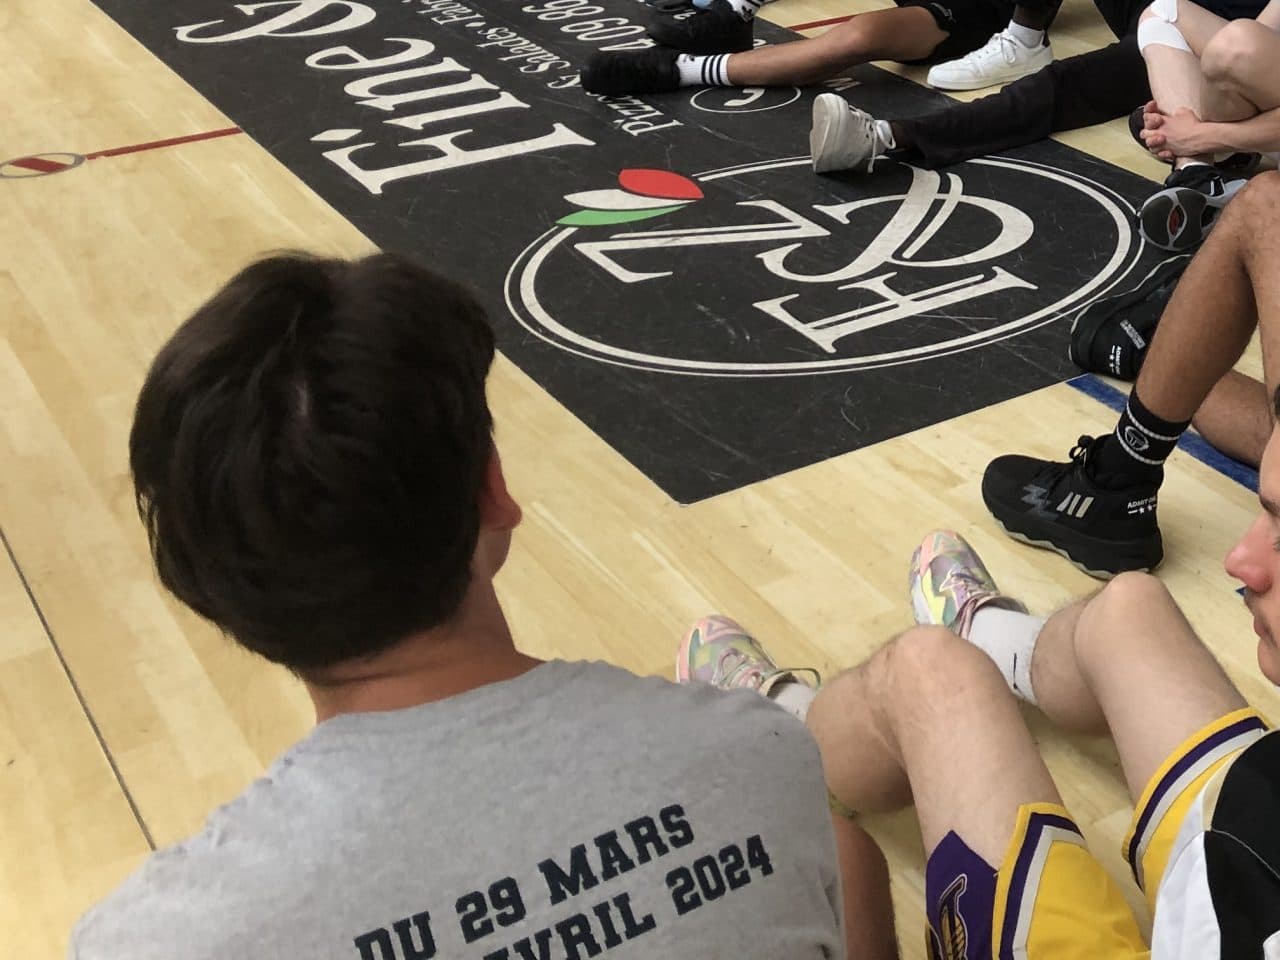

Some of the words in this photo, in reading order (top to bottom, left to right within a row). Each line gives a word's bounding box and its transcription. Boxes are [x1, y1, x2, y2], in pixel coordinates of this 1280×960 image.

[476, 27, 570, 73] Salades
[522, 0, 604, 20] 86
[560, 18, 645, 41] 09
[305, 38, 596, 194] Fine
[354, 911, 438, 960] DU
[455, 876, 527, 944] 29
[537, 804, 695, 906] MARS
[484, 891, 656, 960] VRIL
[665, 834, 775, 916] 2024
